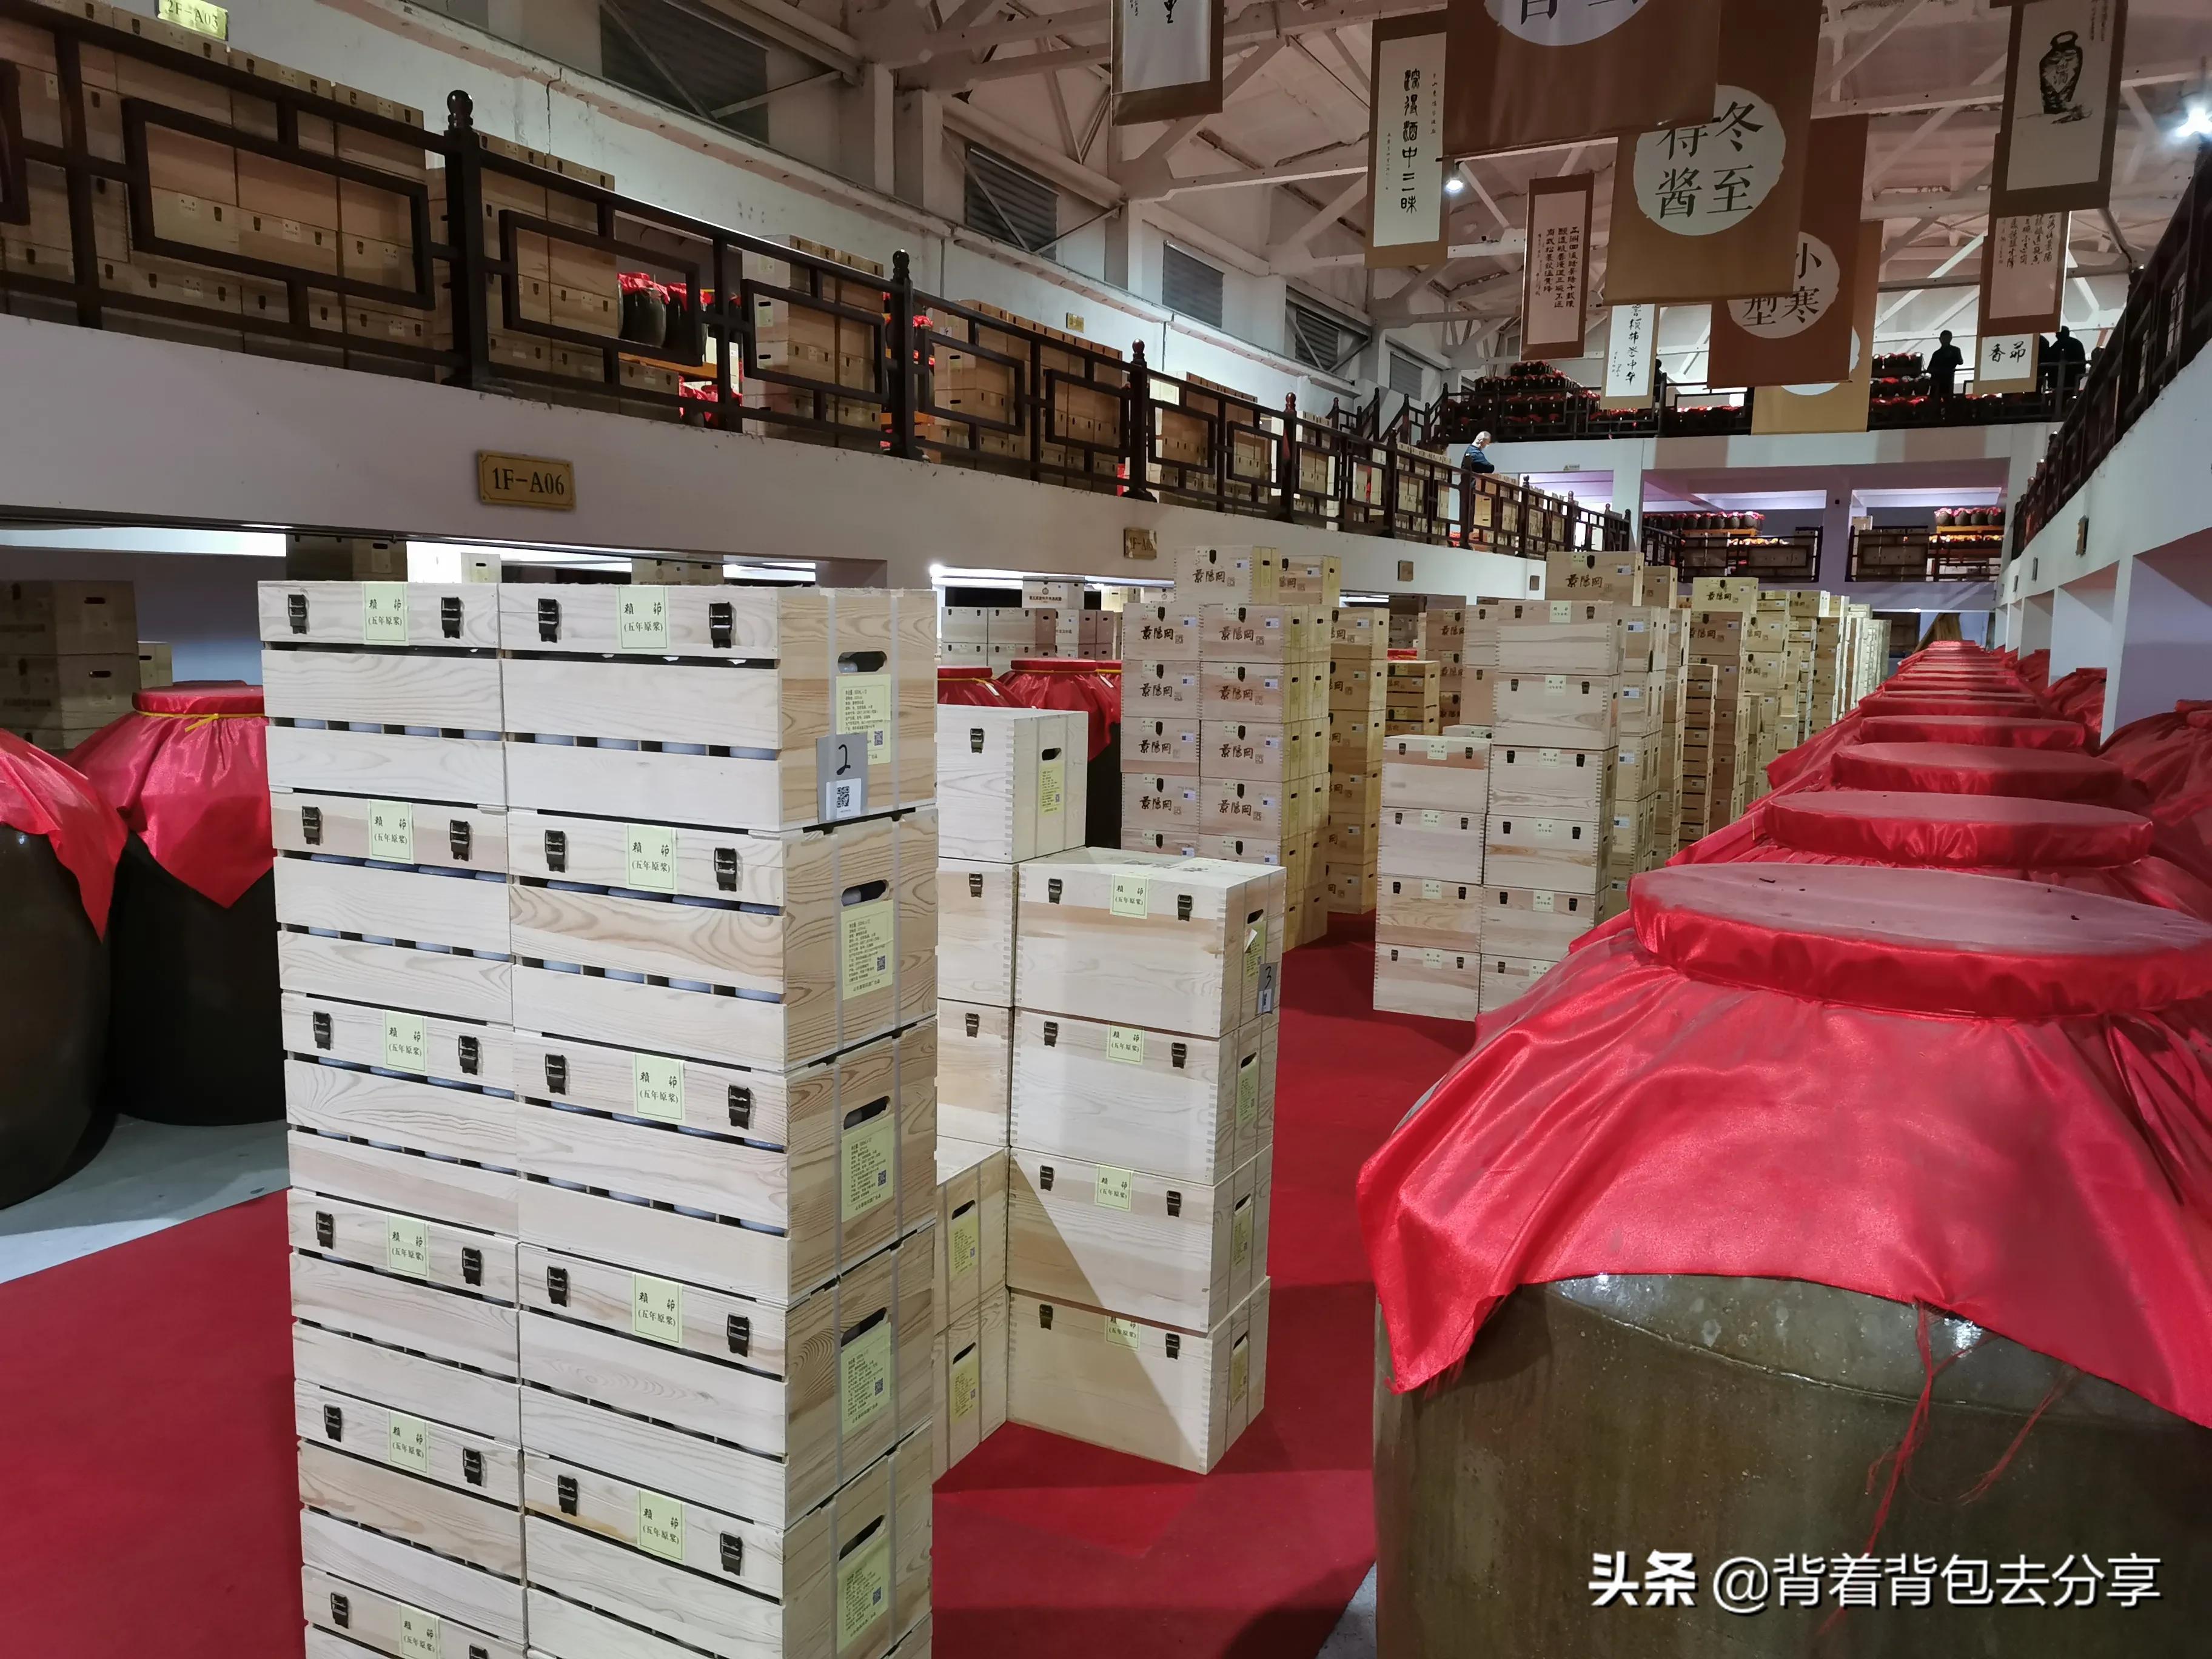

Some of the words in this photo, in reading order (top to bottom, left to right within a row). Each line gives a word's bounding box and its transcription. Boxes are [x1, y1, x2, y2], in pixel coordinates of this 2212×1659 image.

[1706, 101, 1764, 213] 冬至
[1781, 243, 1822, 323] 小寒
[491, 467, 565, 496] 1F-A06
[836, 743, 851, 775] 2
